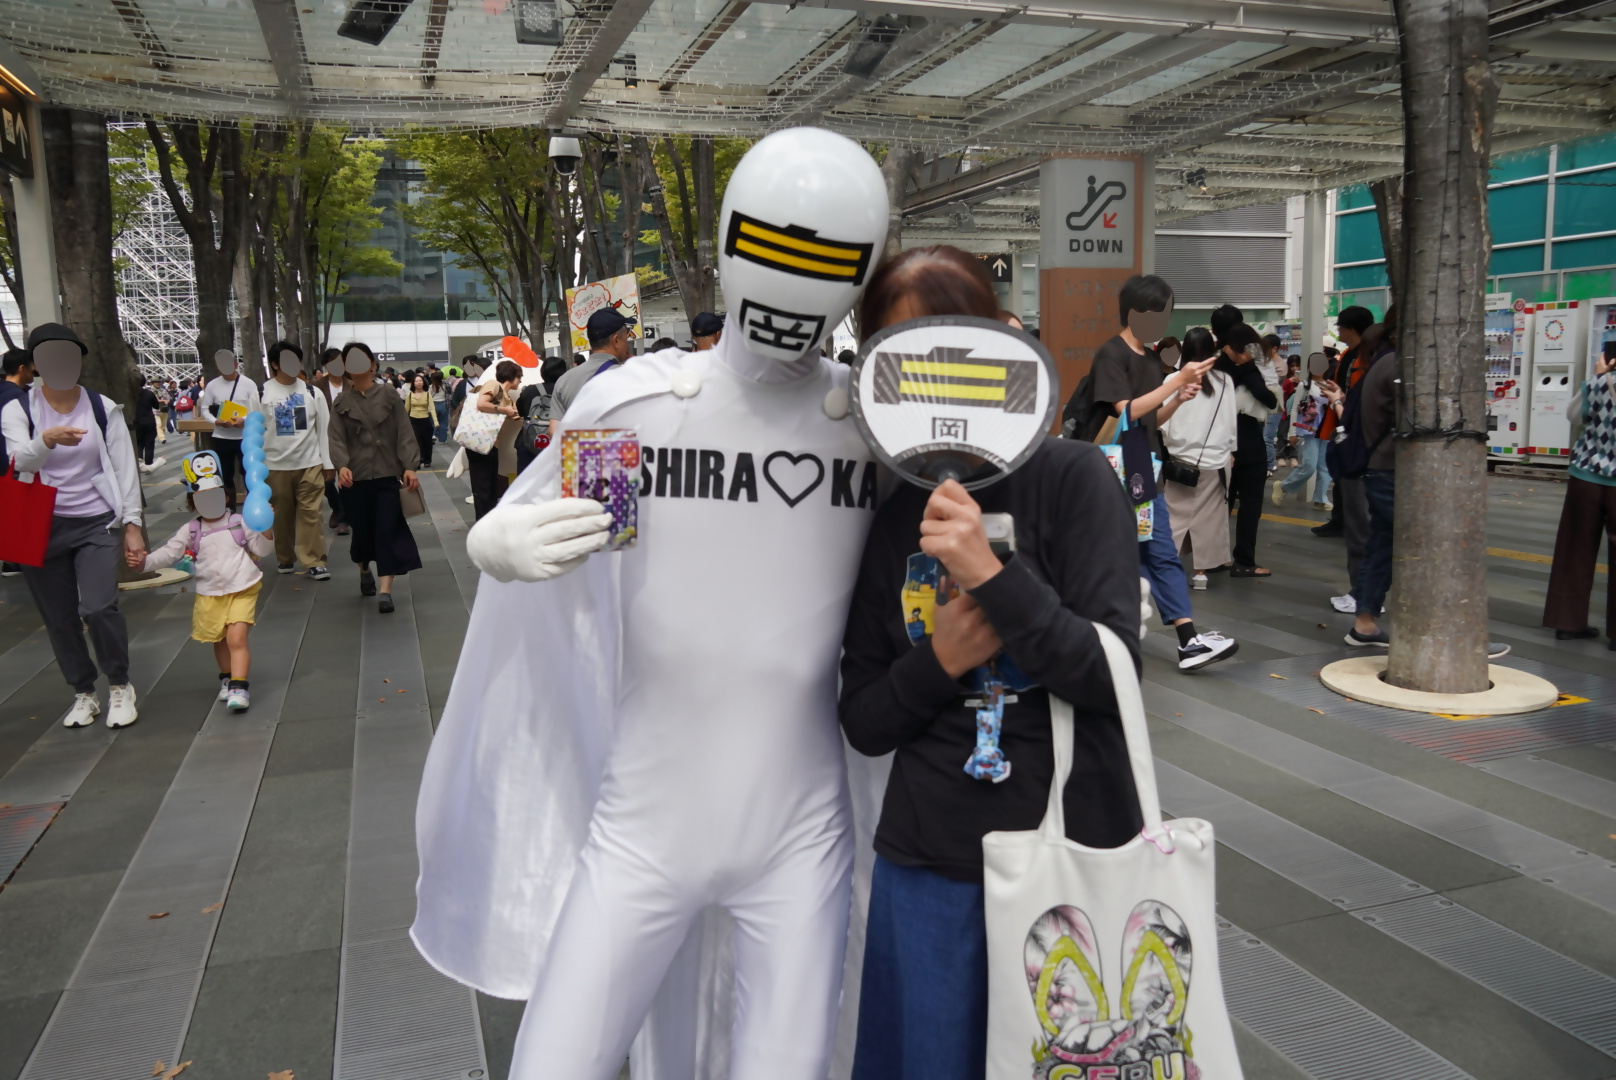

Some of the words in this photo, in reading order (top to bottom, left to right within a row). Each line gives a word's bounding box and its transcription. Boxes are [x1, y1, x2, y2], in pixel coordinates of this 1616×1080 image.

[1069, 239, 1123, 253] DOWN
[1064, 281, 1120, 297] レストラ
[378, 353, 385, 361] C
[638, 446, 758, 502] SHIRA
